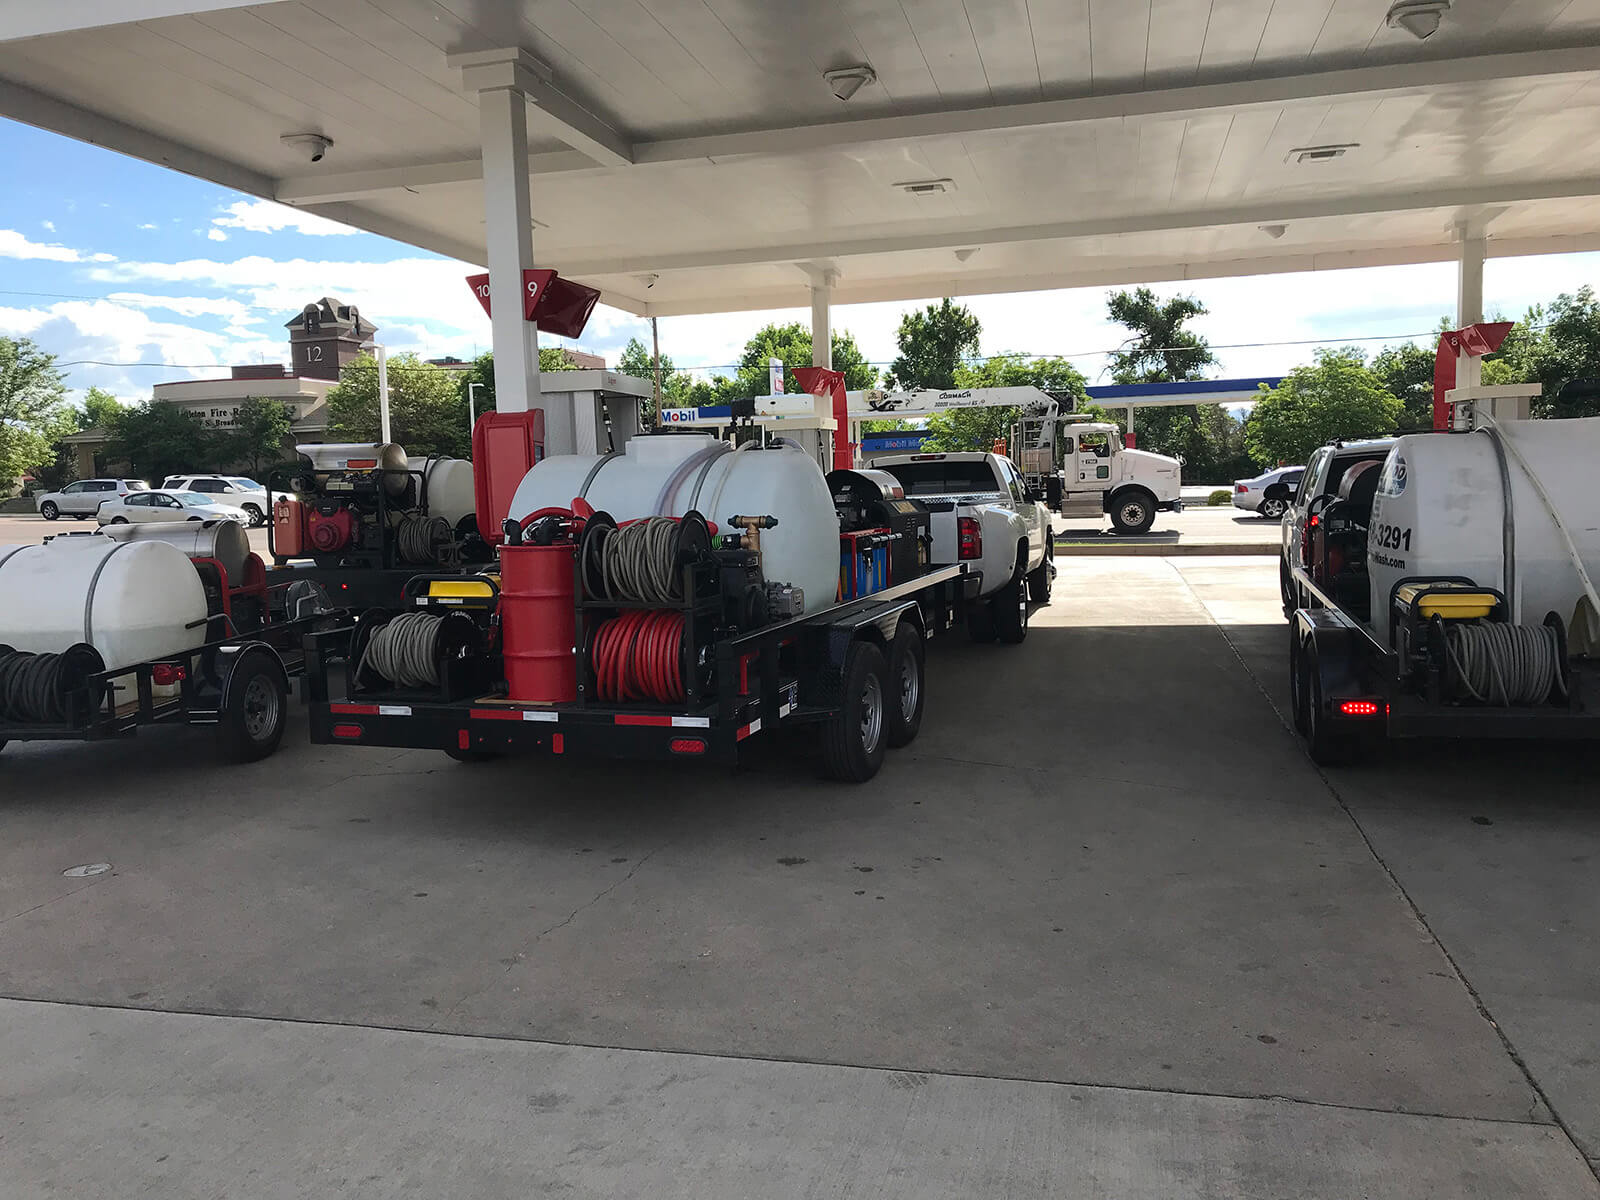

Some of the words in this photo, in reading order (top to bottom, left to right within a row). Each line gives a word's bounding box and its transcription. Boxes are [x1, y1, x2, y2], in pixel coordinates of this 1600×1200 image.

[476, 284, 490, 298] 10
[527, 281, 538, 298] 9
[1451, 336, 1458, 346] 8
[306, 346, 323, 362] 12
[210, 408, 228, 417] Fire
[661, 410, 696, 422] Mobil
[885, 440, 907, 449] Mobil
